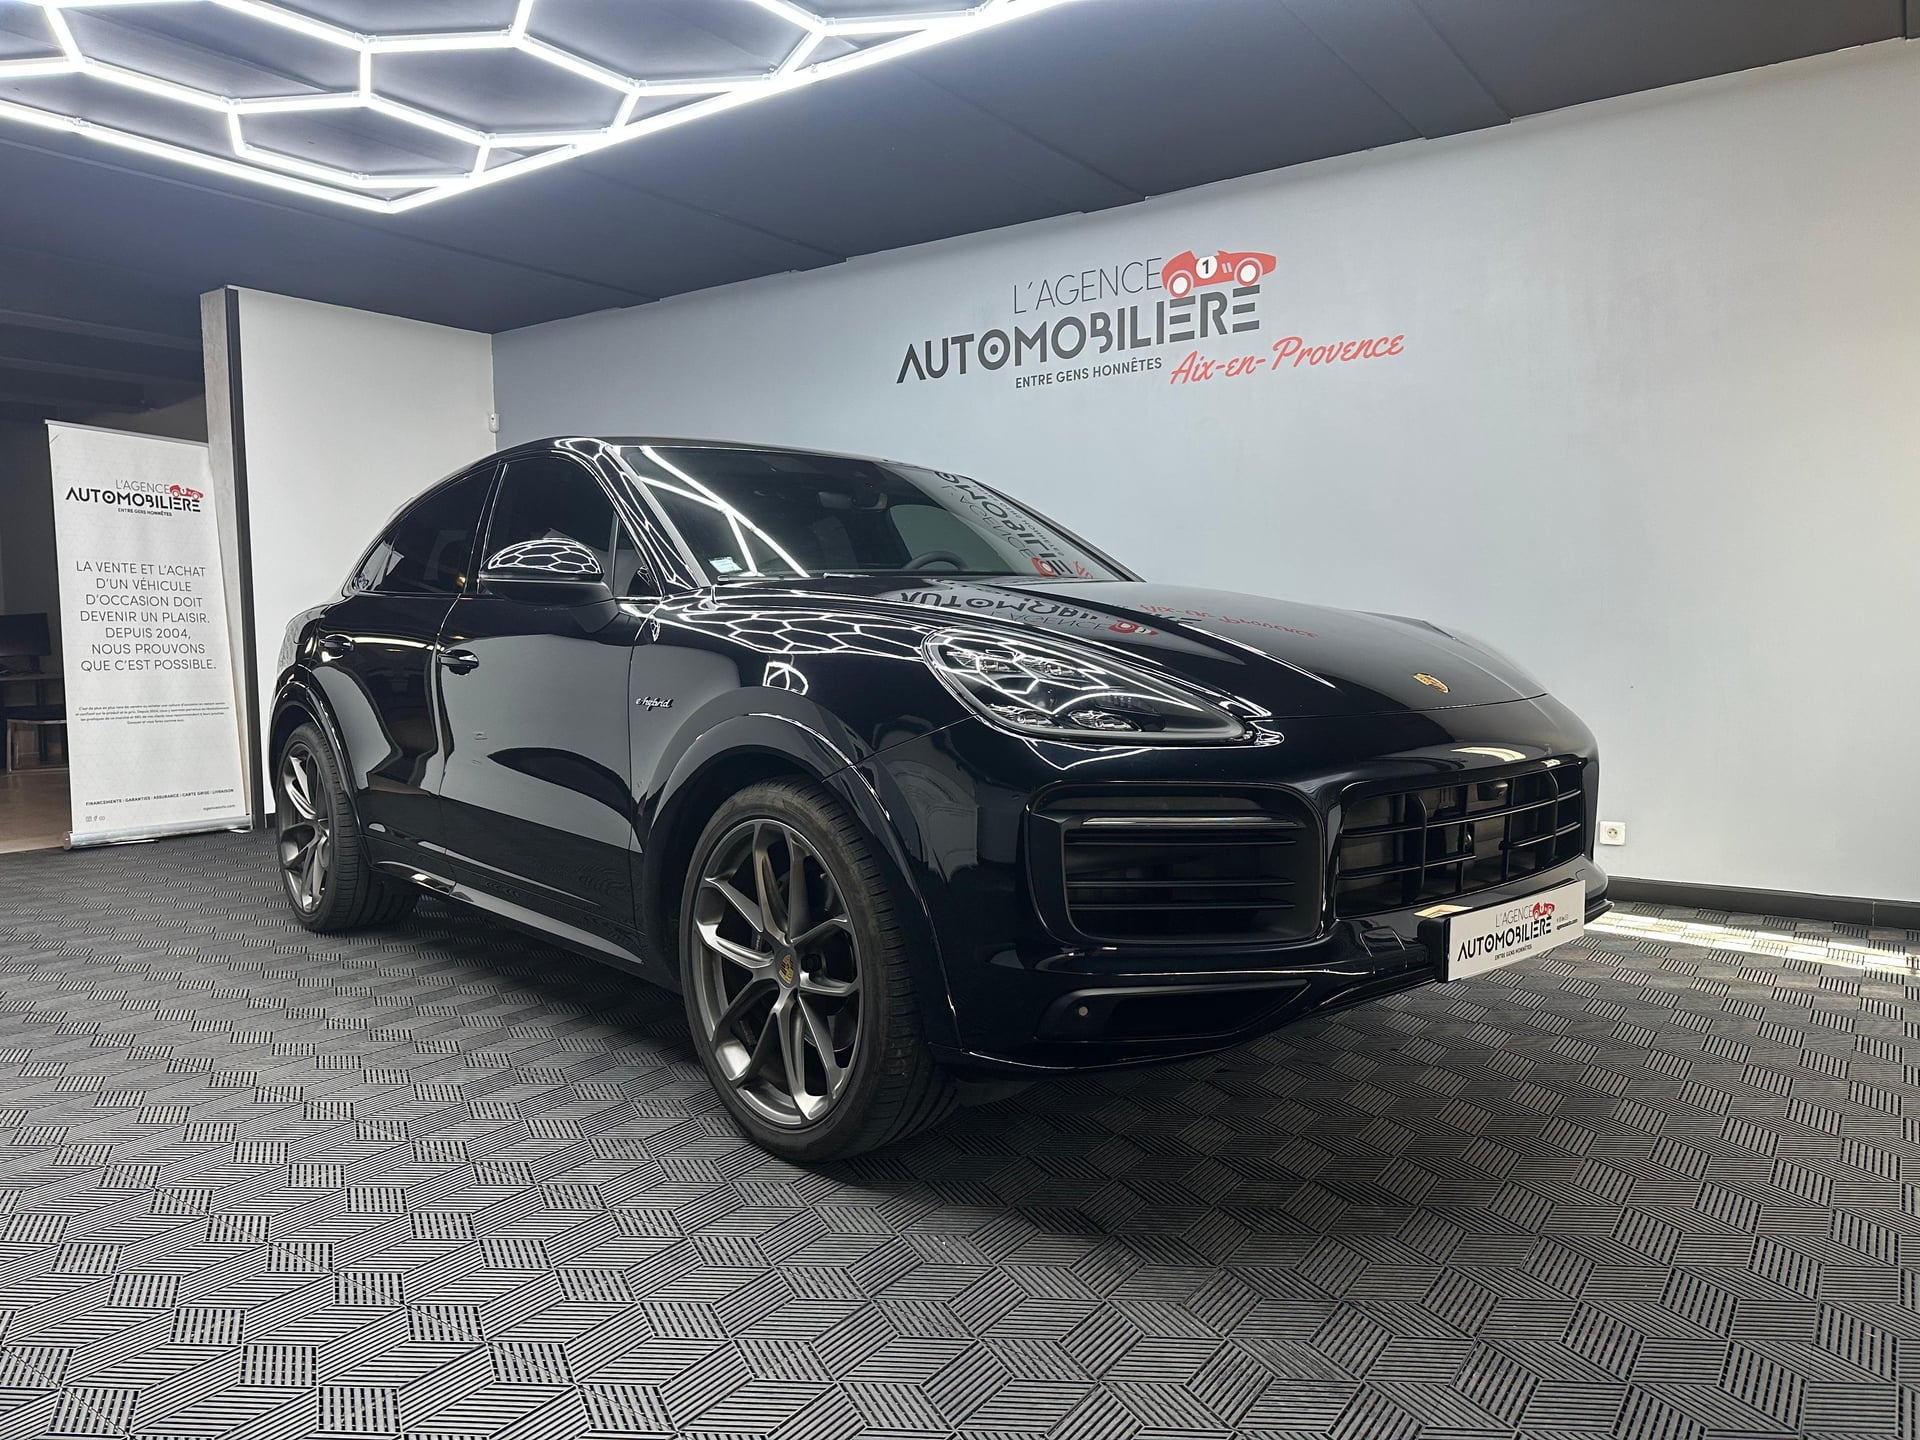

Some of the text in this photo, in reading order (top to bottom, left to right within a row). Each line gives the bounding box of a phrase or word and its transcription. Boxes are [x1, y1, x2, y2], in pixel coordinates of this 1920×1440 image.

[1014, 257, 1162, 314] L'AGENCE
[1015, 356, 1162, 389] ENTRE GENS HONNÊTES
[115, 479, 170, 495] L'AGENCE
[76, 560, 206, 576] LA VENTE ET L'ACHAT
[96, 577, 192, 592] D'UN VÉHICULE
[85, 594, 203, 607] D'OCCASION DOIT
[80, 610, 210, 623] DEVENIR UN PLAISIR.
[105, 627, 191, 640] DEPUIS 2004,
[91, 643, 205, 654] NOUS PROUVONS
[81, 659, 216, 672] QUE C'EST POSSIBLE.
[85, 798, 122, 806] FINANCEMENTS
[1495, 904, 1534, 928] L'AGENCE
